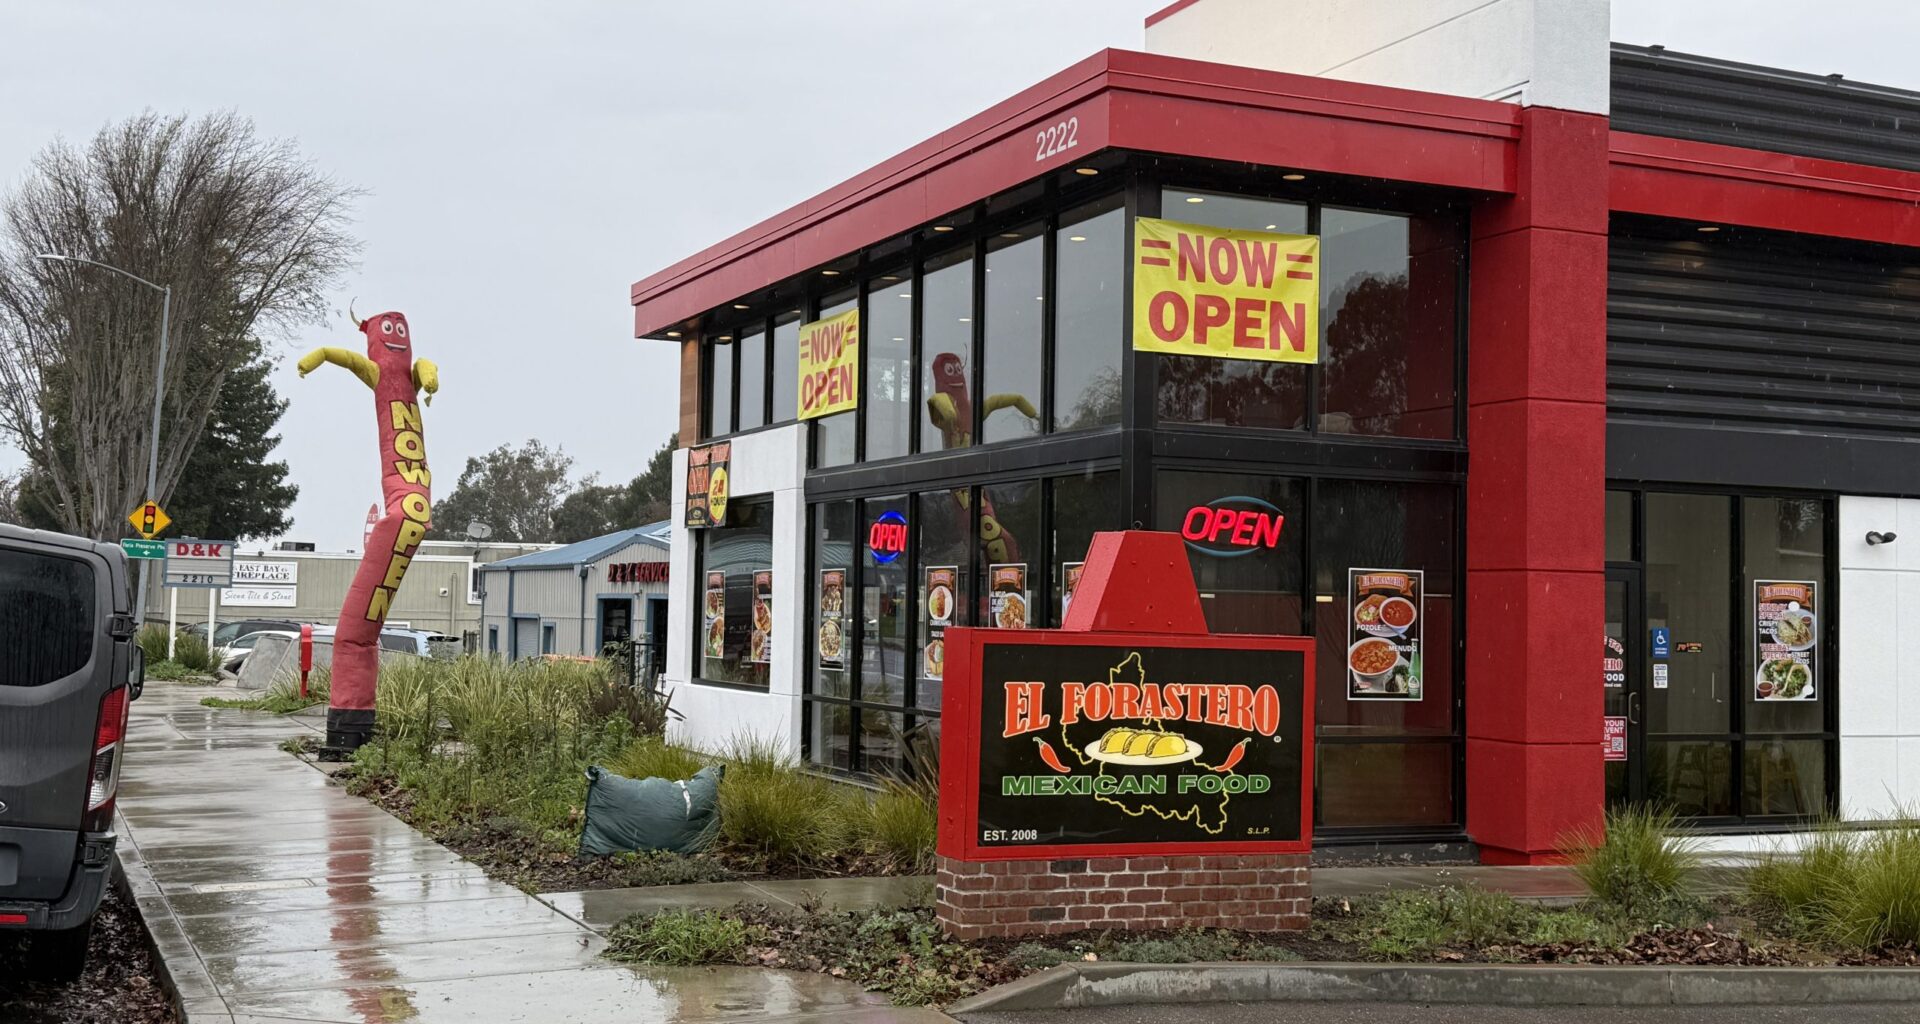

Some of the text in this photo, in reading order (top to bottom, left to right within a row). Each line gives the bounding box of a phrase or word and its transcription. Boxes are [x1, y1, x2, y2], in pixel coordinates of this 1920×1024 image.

[1036, 116, 1078, 162] 2222
[1177, 232, 1278, 289] NOW
[1148, 290, 1305, 352] OPEN
[810, 321, 844, 365] NOW
[802, 363, 854, 412] OPEN
[713, 480, 724, 495] 24
[365, 400, 432, 623] NOW OPEN
[1182, 506, 1284, 548] OPEN
[870, 522, 908, 552] OPEN
[183, 575, 213, 583] 2210
[248, 591, 262, 600] Tile
[272, 591, 292, 600] Stone
[1003, 682, 1280, 738] EL FORASTERO
[1002, 774, 1270, 796] MEXICAN FOOD
[984, 829, 1037, 841] EST. 2008
